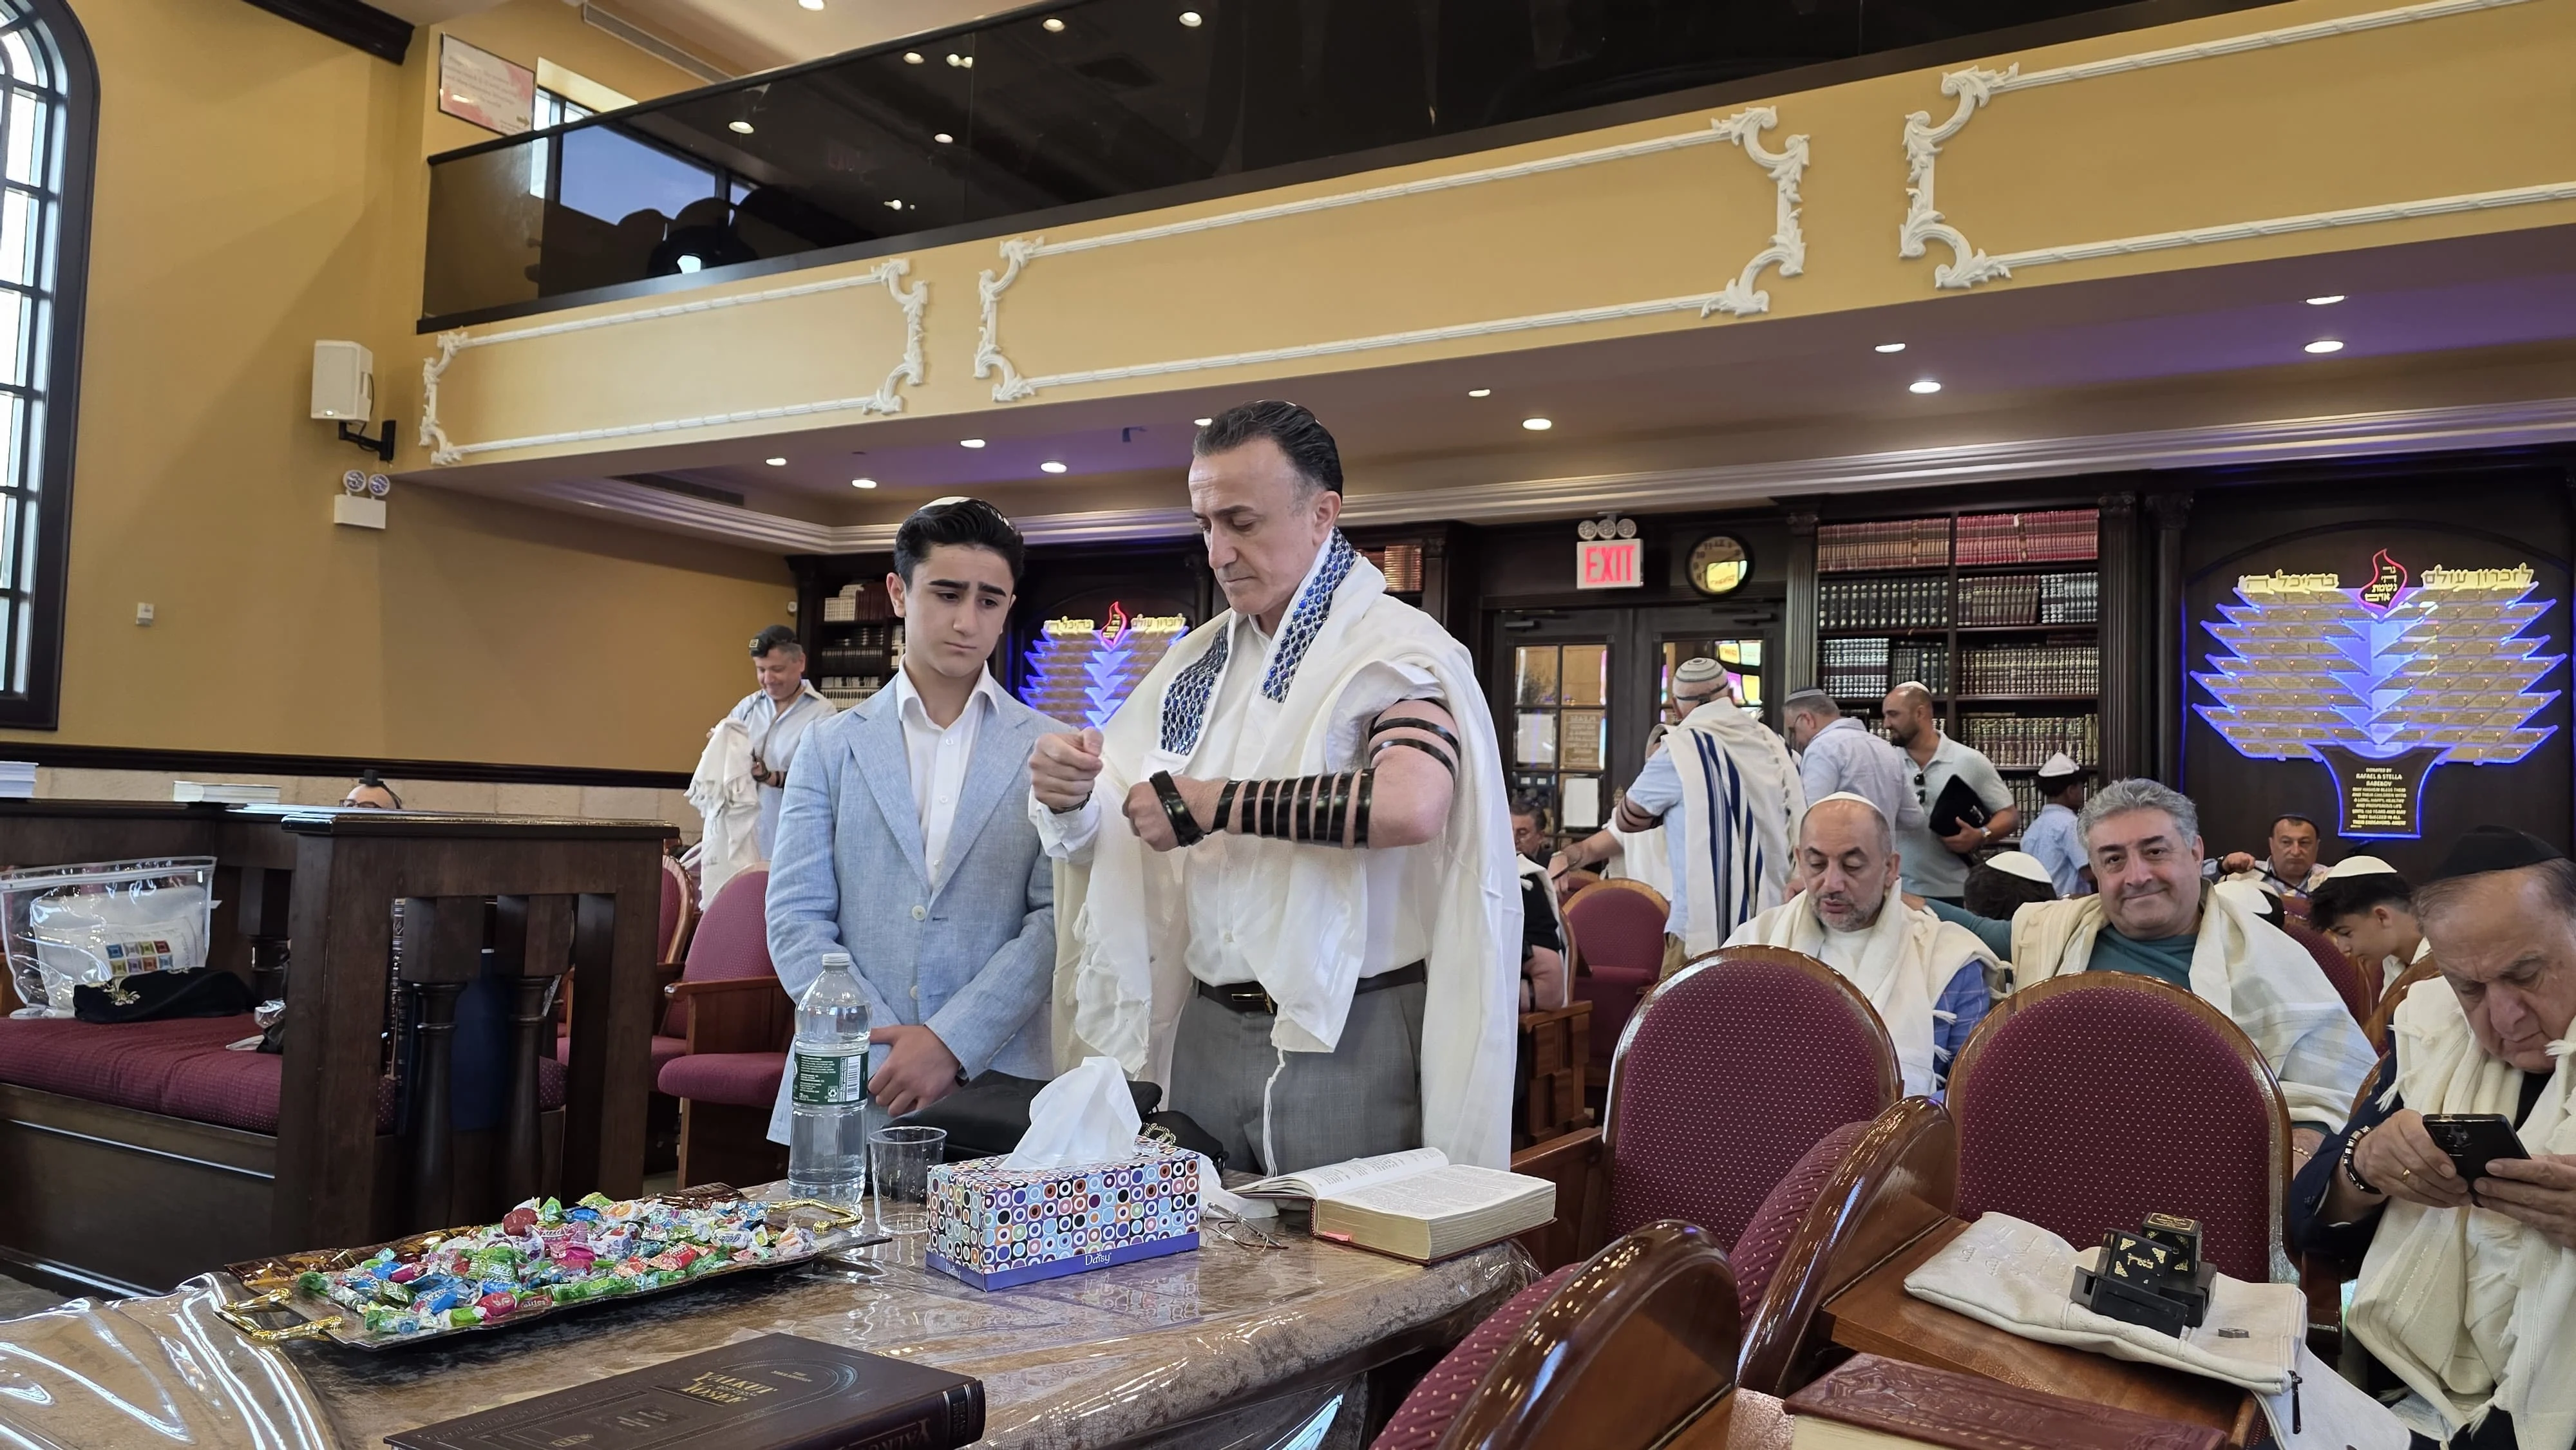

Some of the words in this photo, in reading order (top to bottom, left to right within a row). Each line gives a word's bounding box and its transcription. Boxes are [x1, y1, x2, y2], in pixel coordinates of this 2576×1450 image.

[1585, 545, 1635, 583] EXIT
[2476, 564, 2532, 585] לזכרון
[2425, 567, 2467, 584] עולם
[1085, 1252, 1111, 1266] Daisy
[679, 1381, 749, 1404] YOSEF
[691, 1371, 779, 1394] YALKUT
